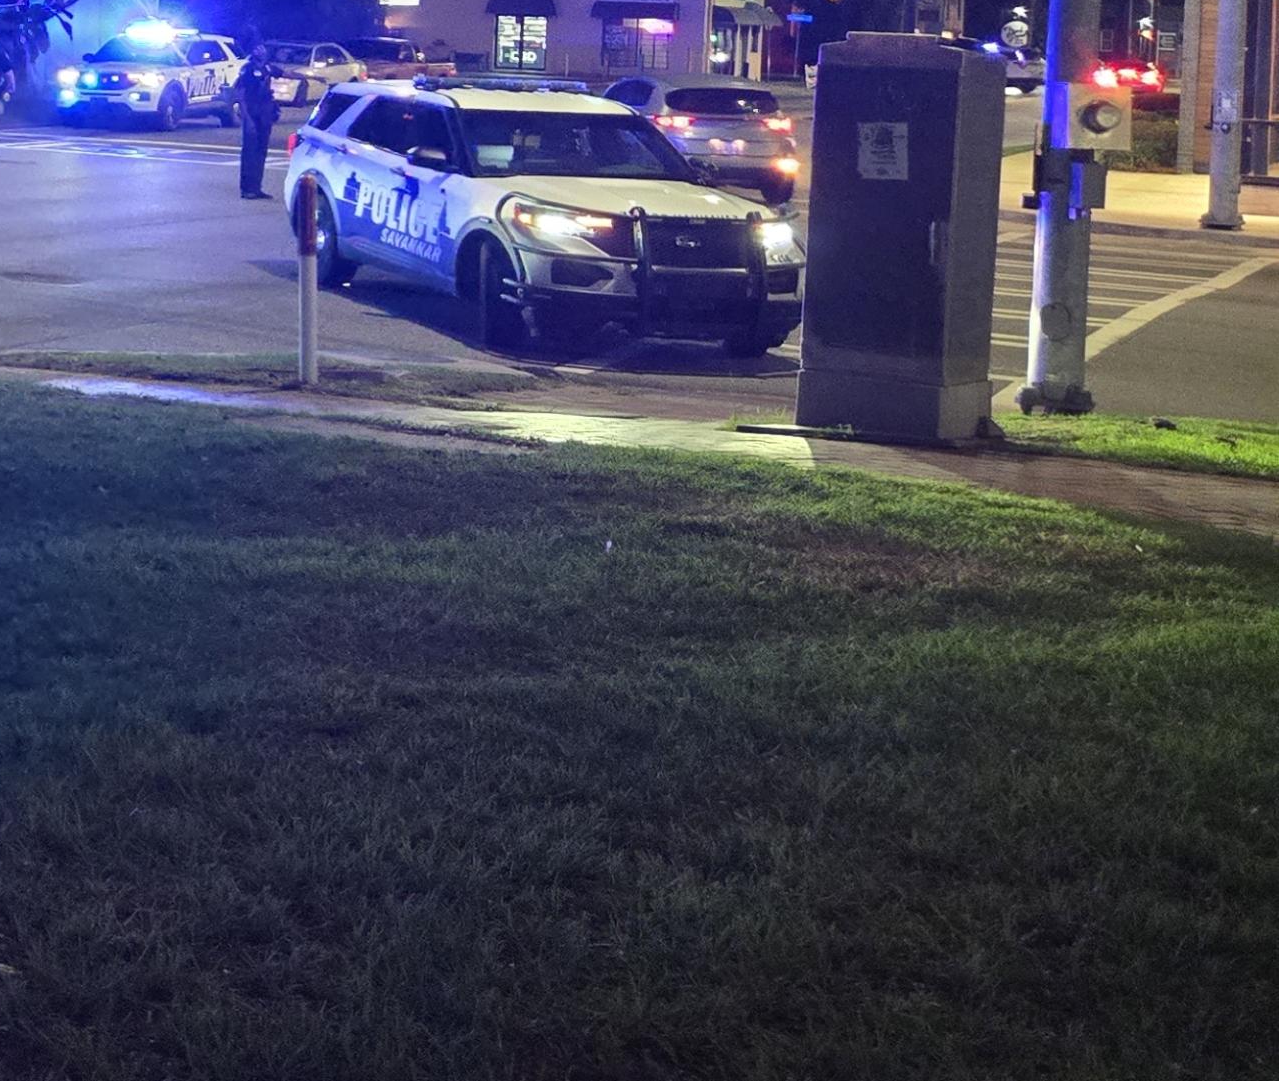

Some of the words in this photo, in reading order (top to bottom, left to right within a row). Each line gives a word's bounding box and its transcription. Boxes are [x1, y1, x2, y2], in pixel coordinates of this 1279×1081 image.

[186, 76, 221, 97] POLICE
[354, 179, 441, 245] POLICE
[380, 228, 442, 262] SAVANNAH
